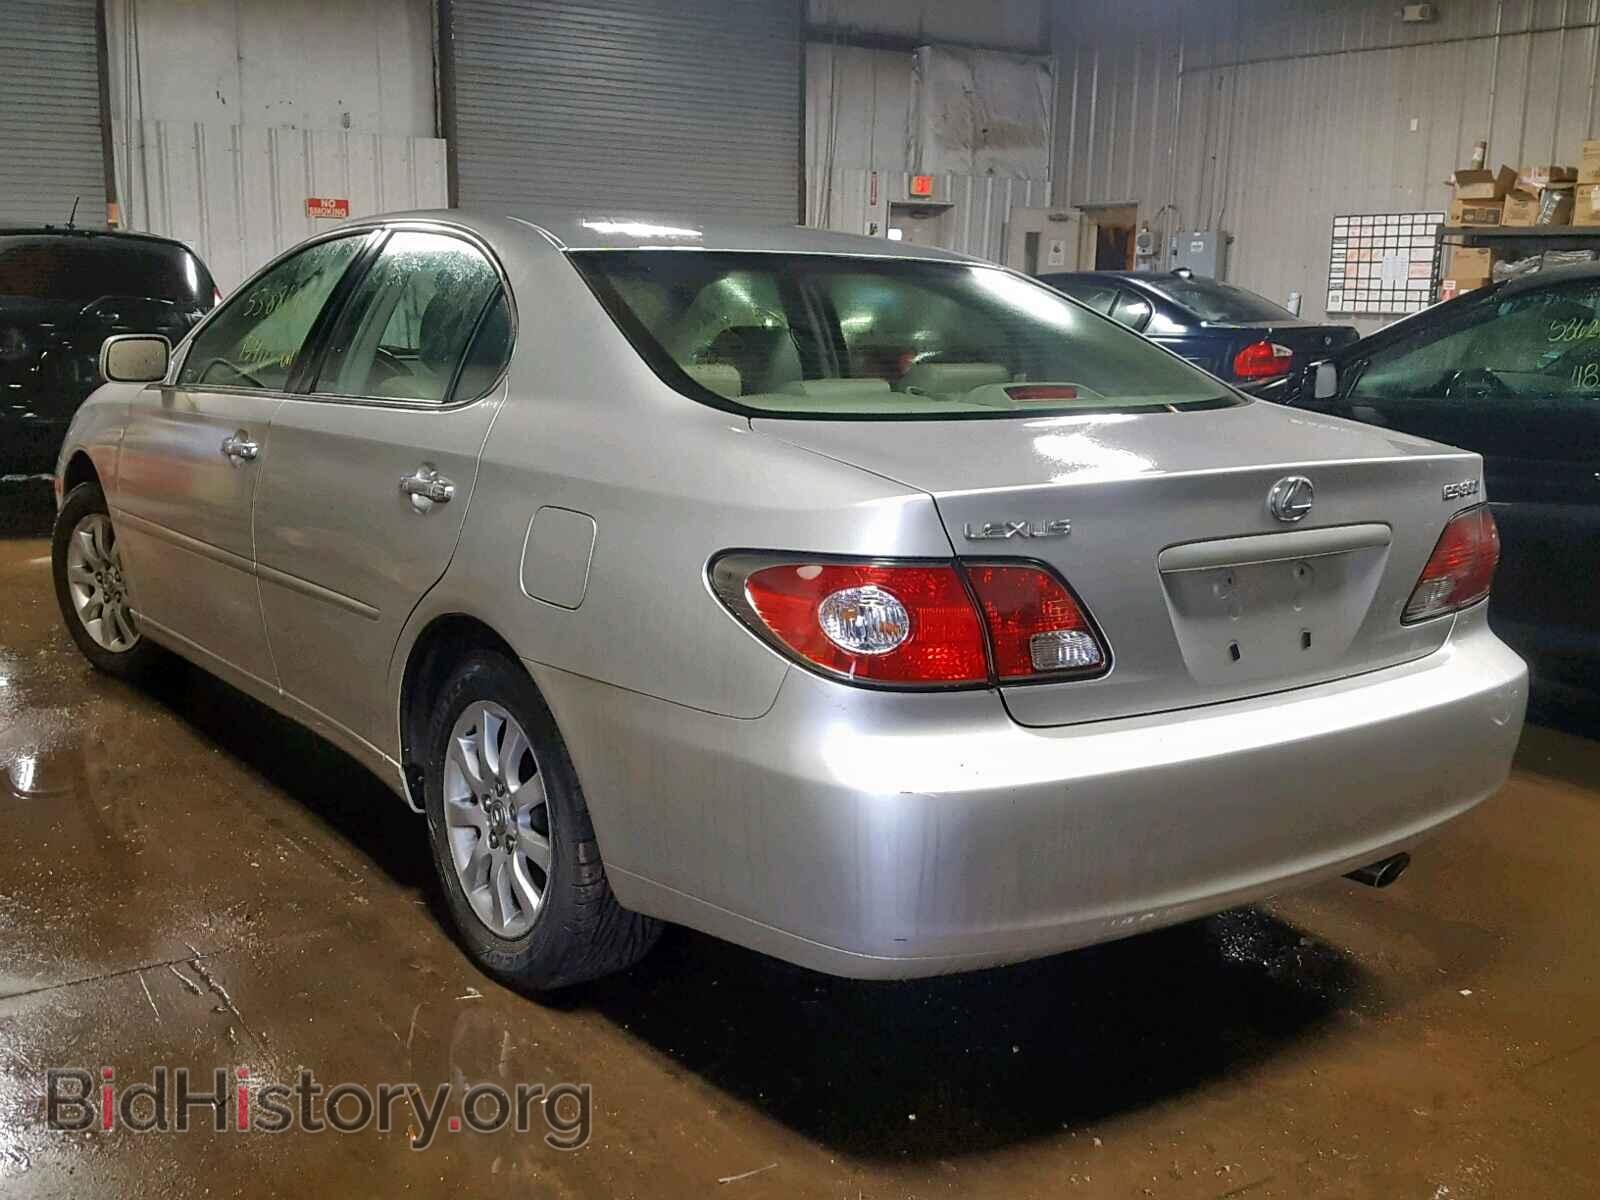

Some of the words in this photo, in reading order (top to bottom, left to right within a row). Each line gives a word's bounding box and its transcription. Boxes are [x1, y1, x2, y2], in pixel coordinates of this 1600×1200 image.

[320, 199, 336, 208] NO
[309, 207, 346, 217] SMOKING
[963, 519, 1072, 540] LEXUS
